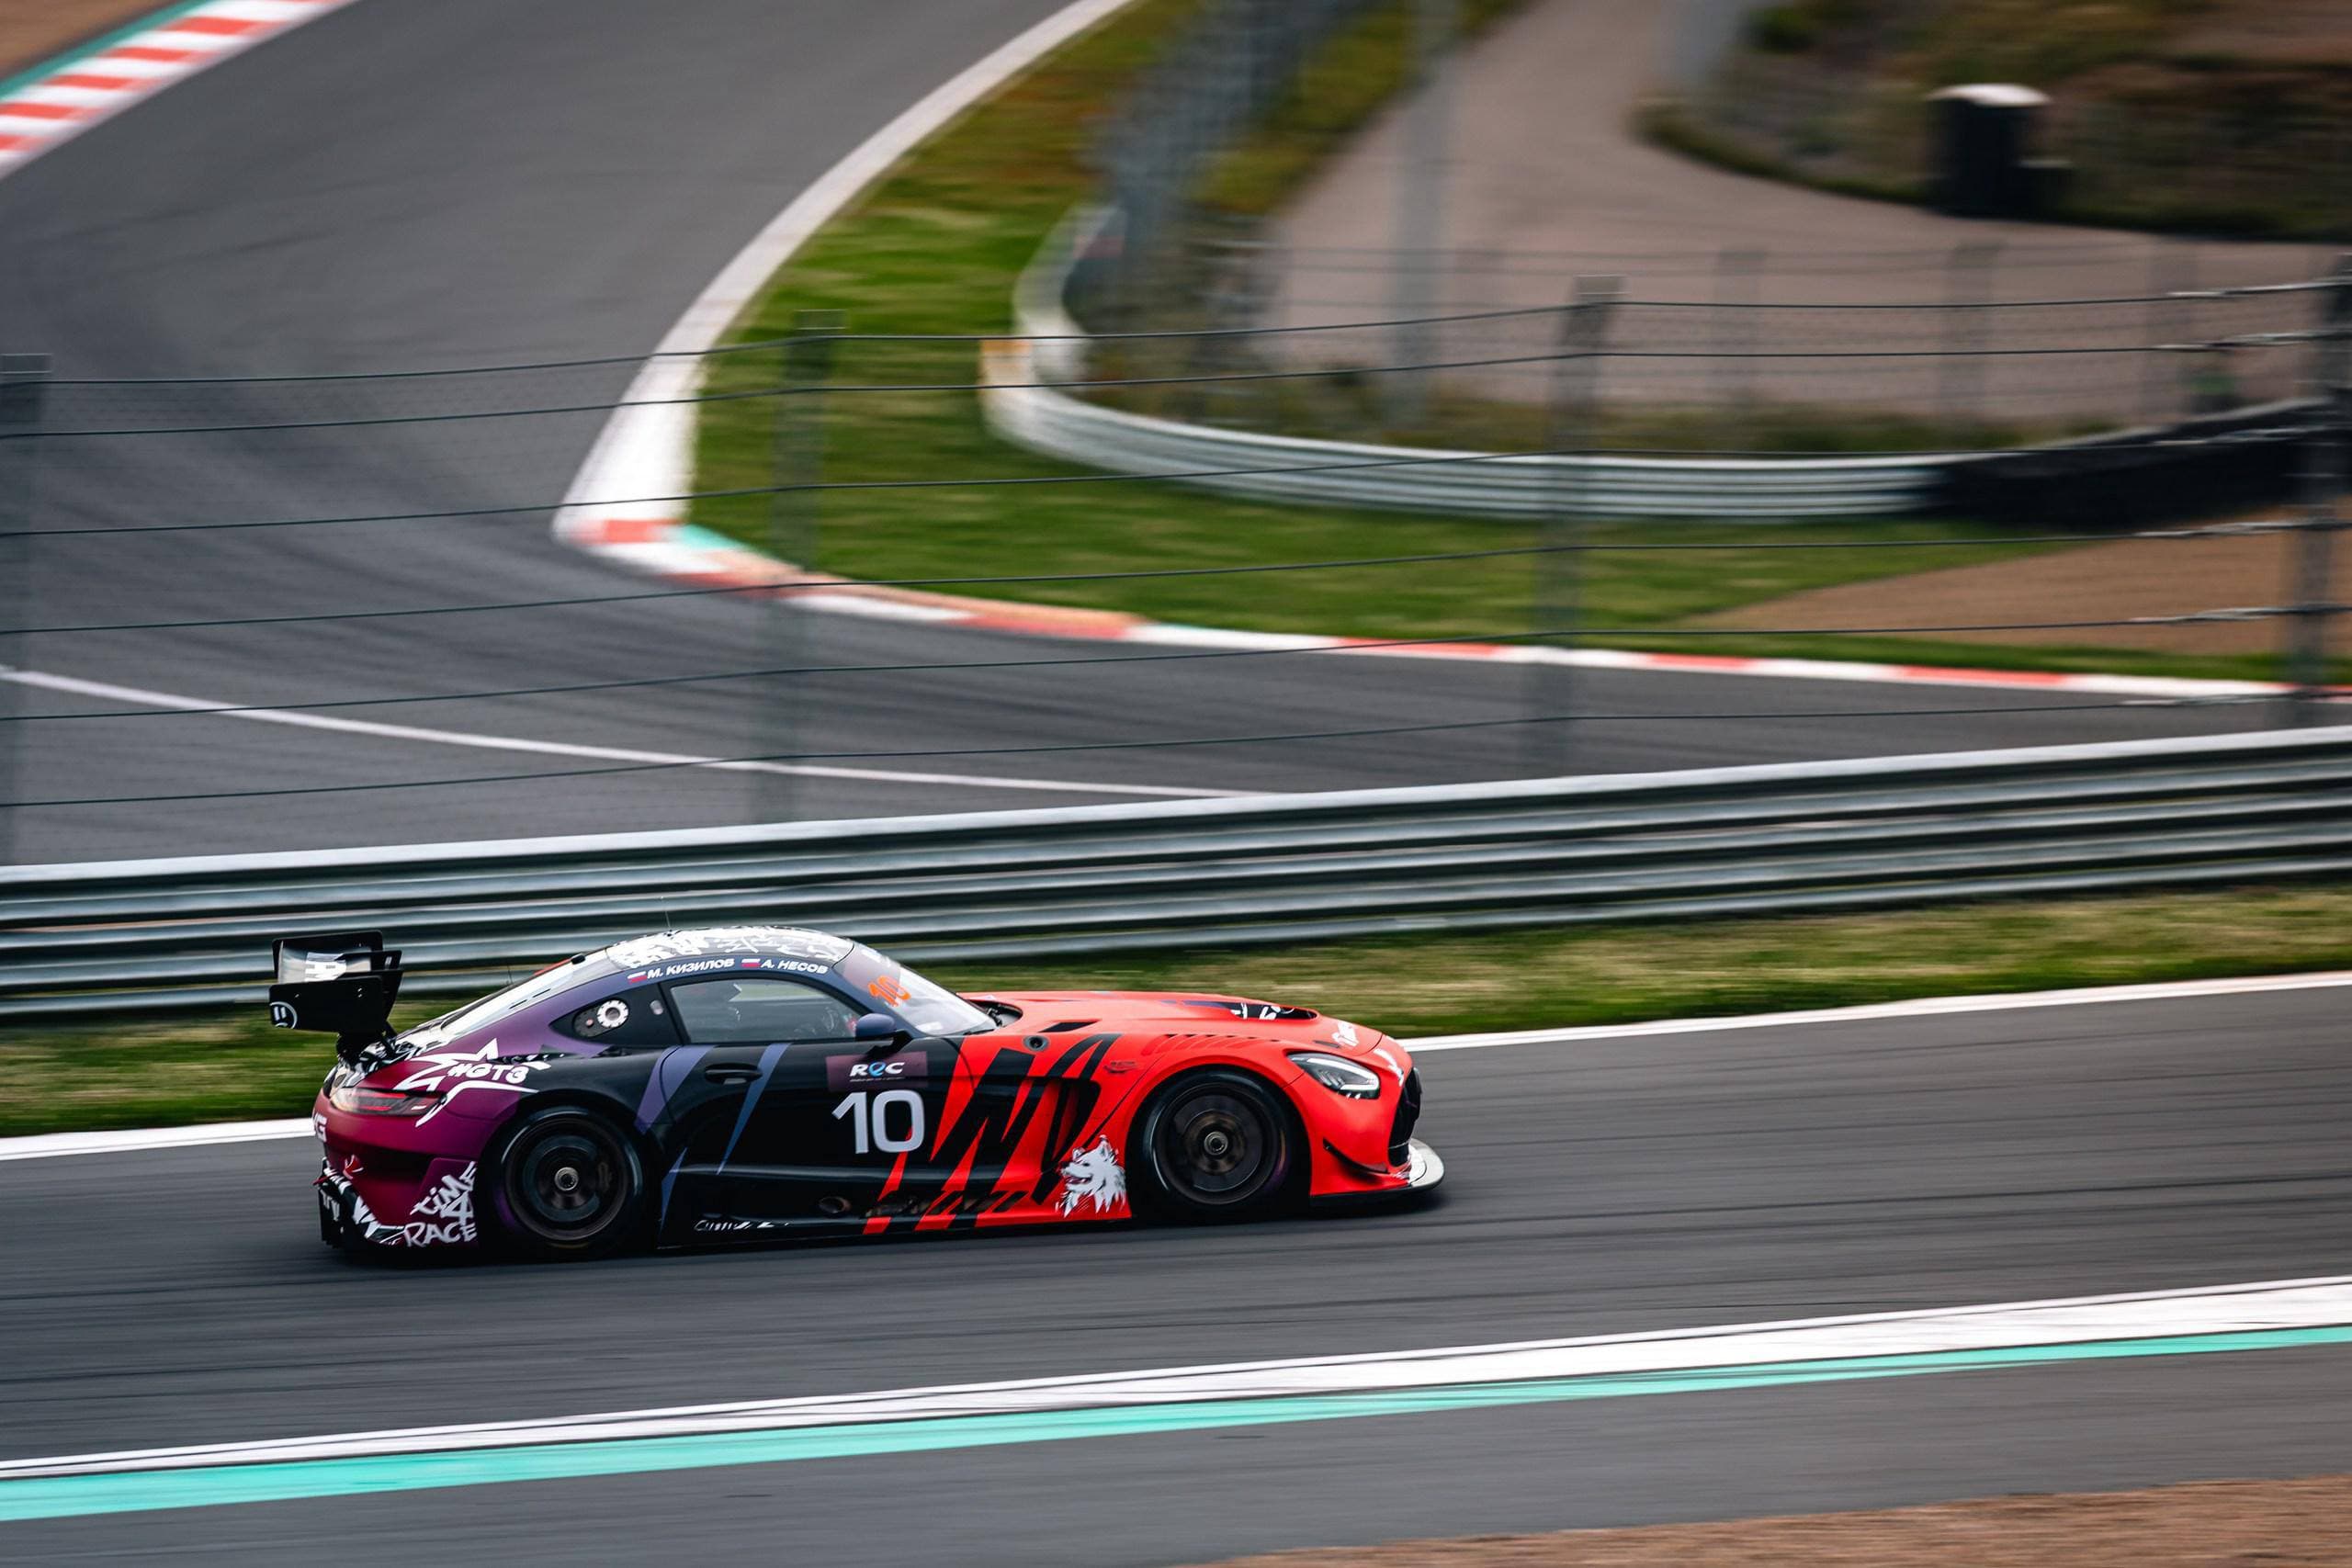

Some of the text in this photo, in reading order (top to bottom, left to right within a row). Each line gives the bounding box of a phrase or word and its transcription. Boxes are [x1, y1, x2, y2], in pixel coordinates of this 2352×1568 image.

[647, 958, 735, 979] М. КИЗИЛОВ
[761, 960, 829, 974] А. НЕСОВ
[831, 1089, 925, 1154] 10
[440, 1190, 474, 1226] 4
[403, 1222, 478, 1247] RACE
